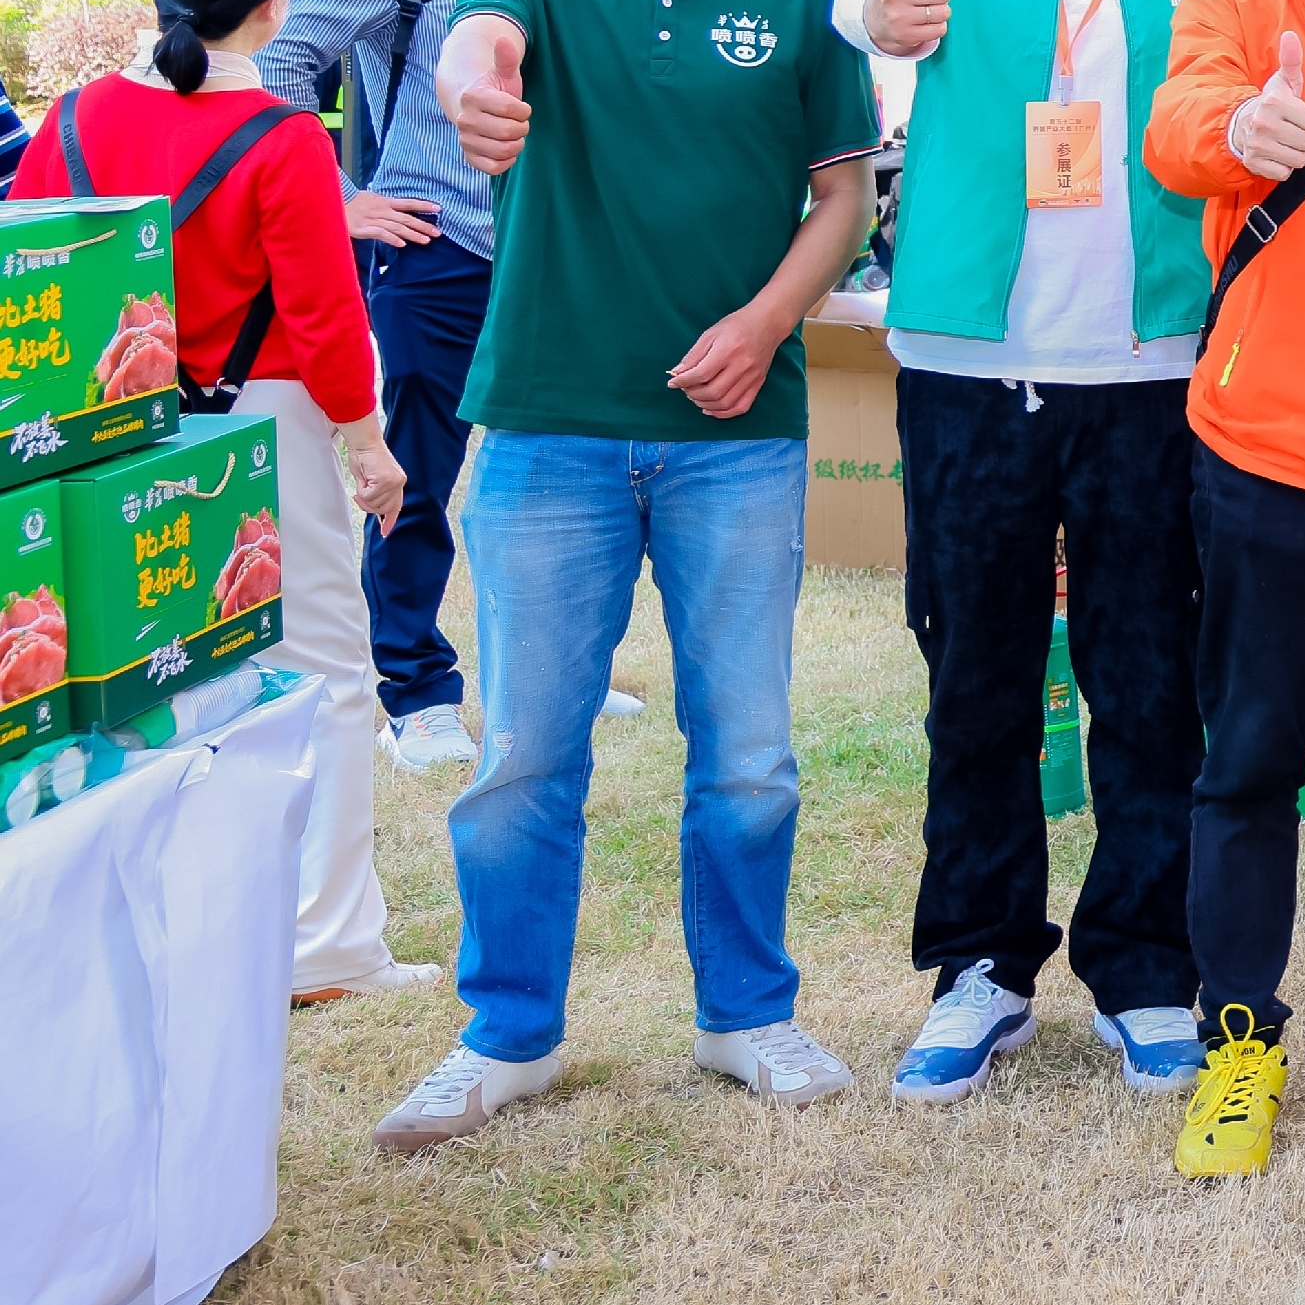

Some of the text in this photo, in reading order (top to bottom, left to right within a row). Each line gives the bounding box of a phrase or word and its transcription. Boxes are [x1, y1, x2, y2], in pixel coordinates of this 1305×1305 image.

[710, 28, 778, 49] 喷喷香
[1057, 142, 1072, 189] 参展证
[135, 511, 191, 565] 比土猪
[136, 552, 196, 609] 更好吃
